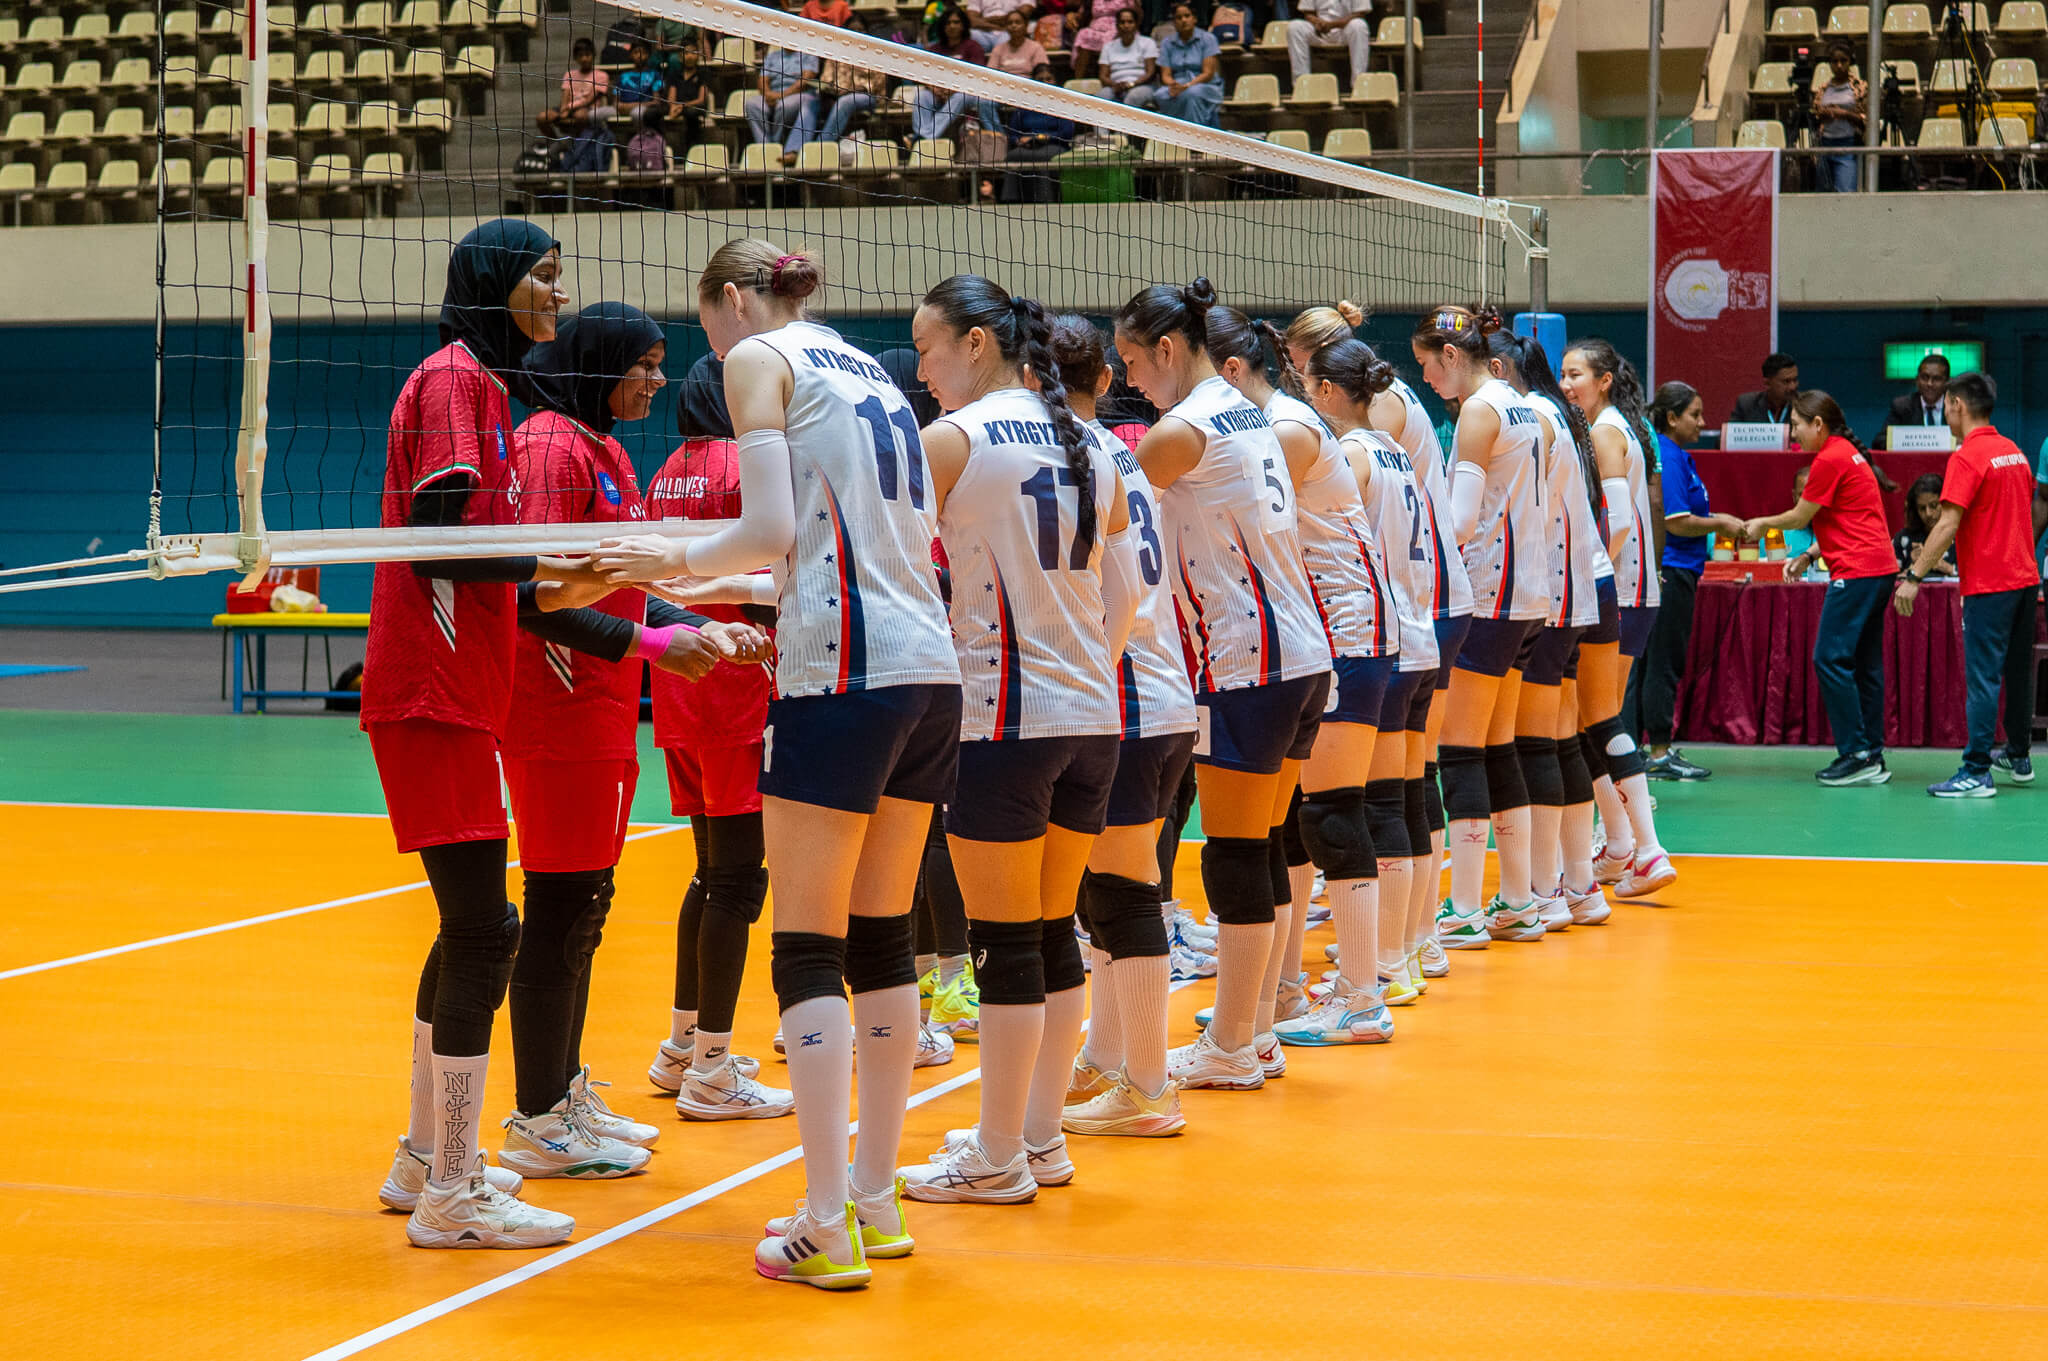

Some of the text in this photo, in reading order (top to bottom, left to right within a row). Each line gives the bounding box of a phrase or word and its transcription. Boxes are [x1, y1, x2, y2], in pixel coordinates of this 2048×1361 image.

[855, 395, 924, 511] 11
[1263, 458, 1285, 513] 5
[1532, 437, 1540, 506] 1
[1021, 467, 1097, 570] 17
[1127, 490, 1162, 585] 3
[1404, 485, 1425, 560] 2
[440, 1071, 472, 1182] NIKE
